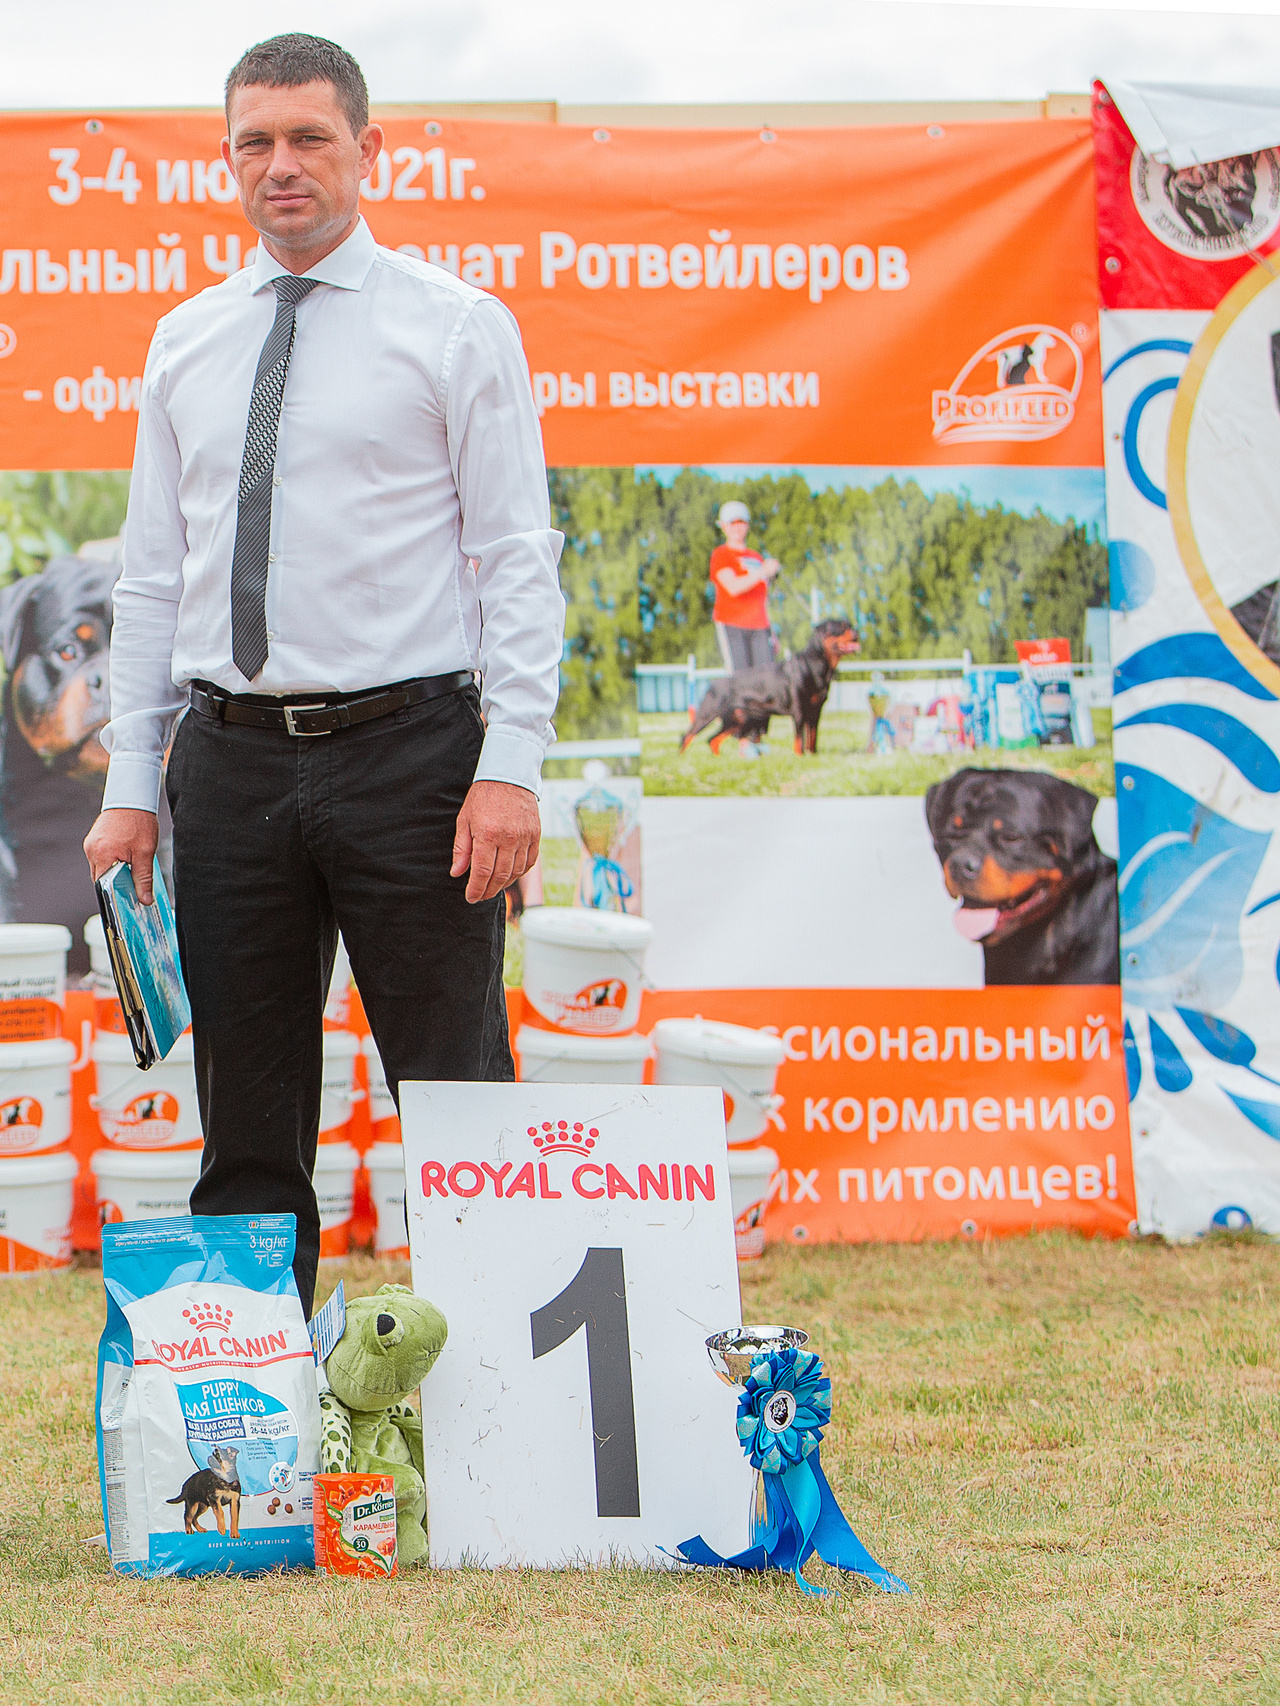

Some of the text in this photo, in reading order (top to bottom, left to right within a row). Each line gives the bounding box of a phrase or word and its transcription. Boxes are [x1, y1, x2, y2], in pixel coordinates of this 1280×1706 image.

[47, 147, 487, 205] 3-4 ию 021г.
[539, 229, 910, 303] Ротвейлеров
[609, 371, 820, 407] выставки
[762, 1014, 1111, 1062] сиональный
[804, 1095, 1116, 1143] кормлению
[421, 1161, 716, 1202] ROYAL CANIN
[838, 1153, 1118, 1209] питомцев!
[250, 1235, 256, 1249] 3
[219, 1330, 287, 1358] CANIN
[202, 1382, 239, 1399] PUPPY
[530, 1247, 641, 1518] 1
[185, 1397, 266, 1418] ДЛЯ ЩЕНКОВ
[357, 1506, 371, 1518] Dr.
[356, 1540, 367, 1549] 30
